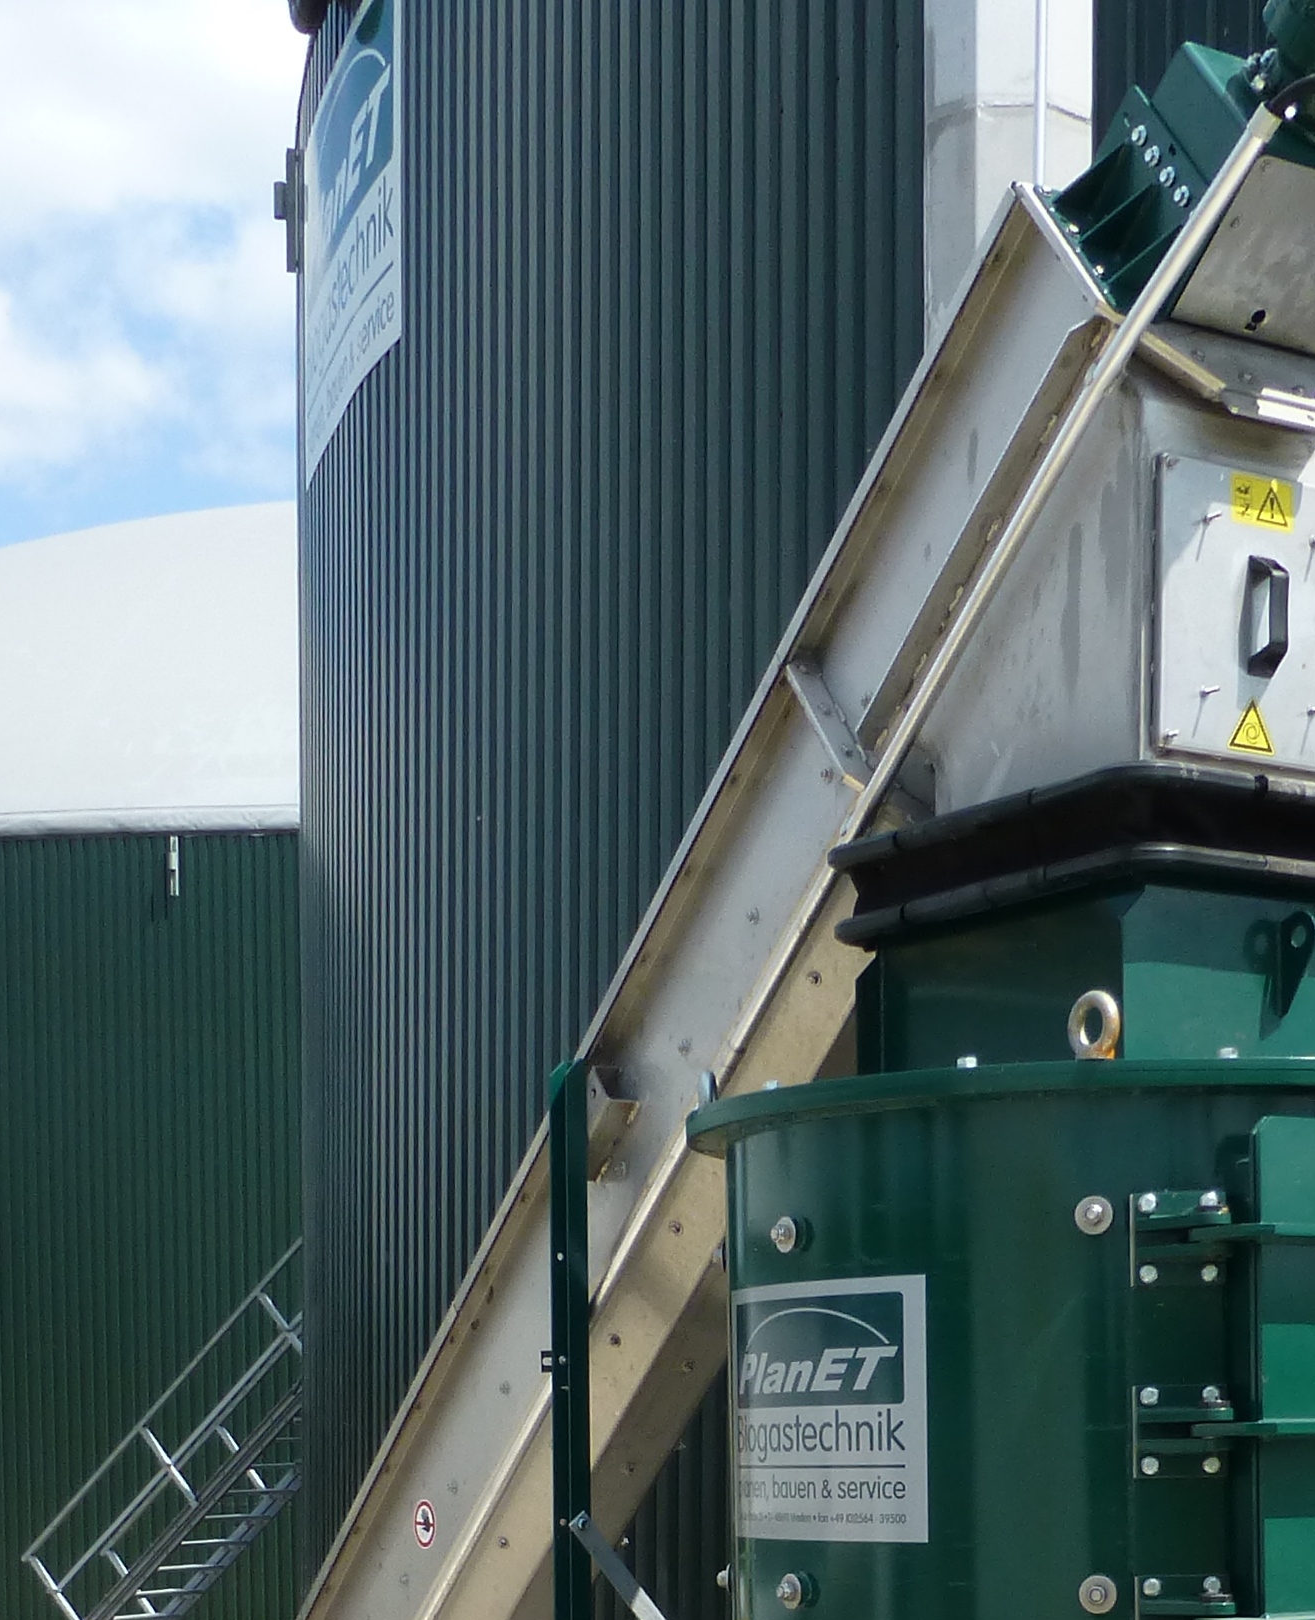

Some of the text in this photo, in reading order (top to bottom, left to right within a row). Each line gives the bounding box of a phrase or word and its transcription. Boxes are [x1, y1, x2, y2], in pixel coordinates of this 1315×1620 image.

[320, 63, 391, 249] anET
[357, 289, 395, 356] service
[739, 1345, 899, 1395] PlanET
[737, 1408, 906, 1463] Biogastechnik
[772, 1474, 817, 1500] bauen
[821, 1480, 833, 1500] &
[837, 1474, 906, 1500] service
[879, 1513, 907, 1525] 39500
